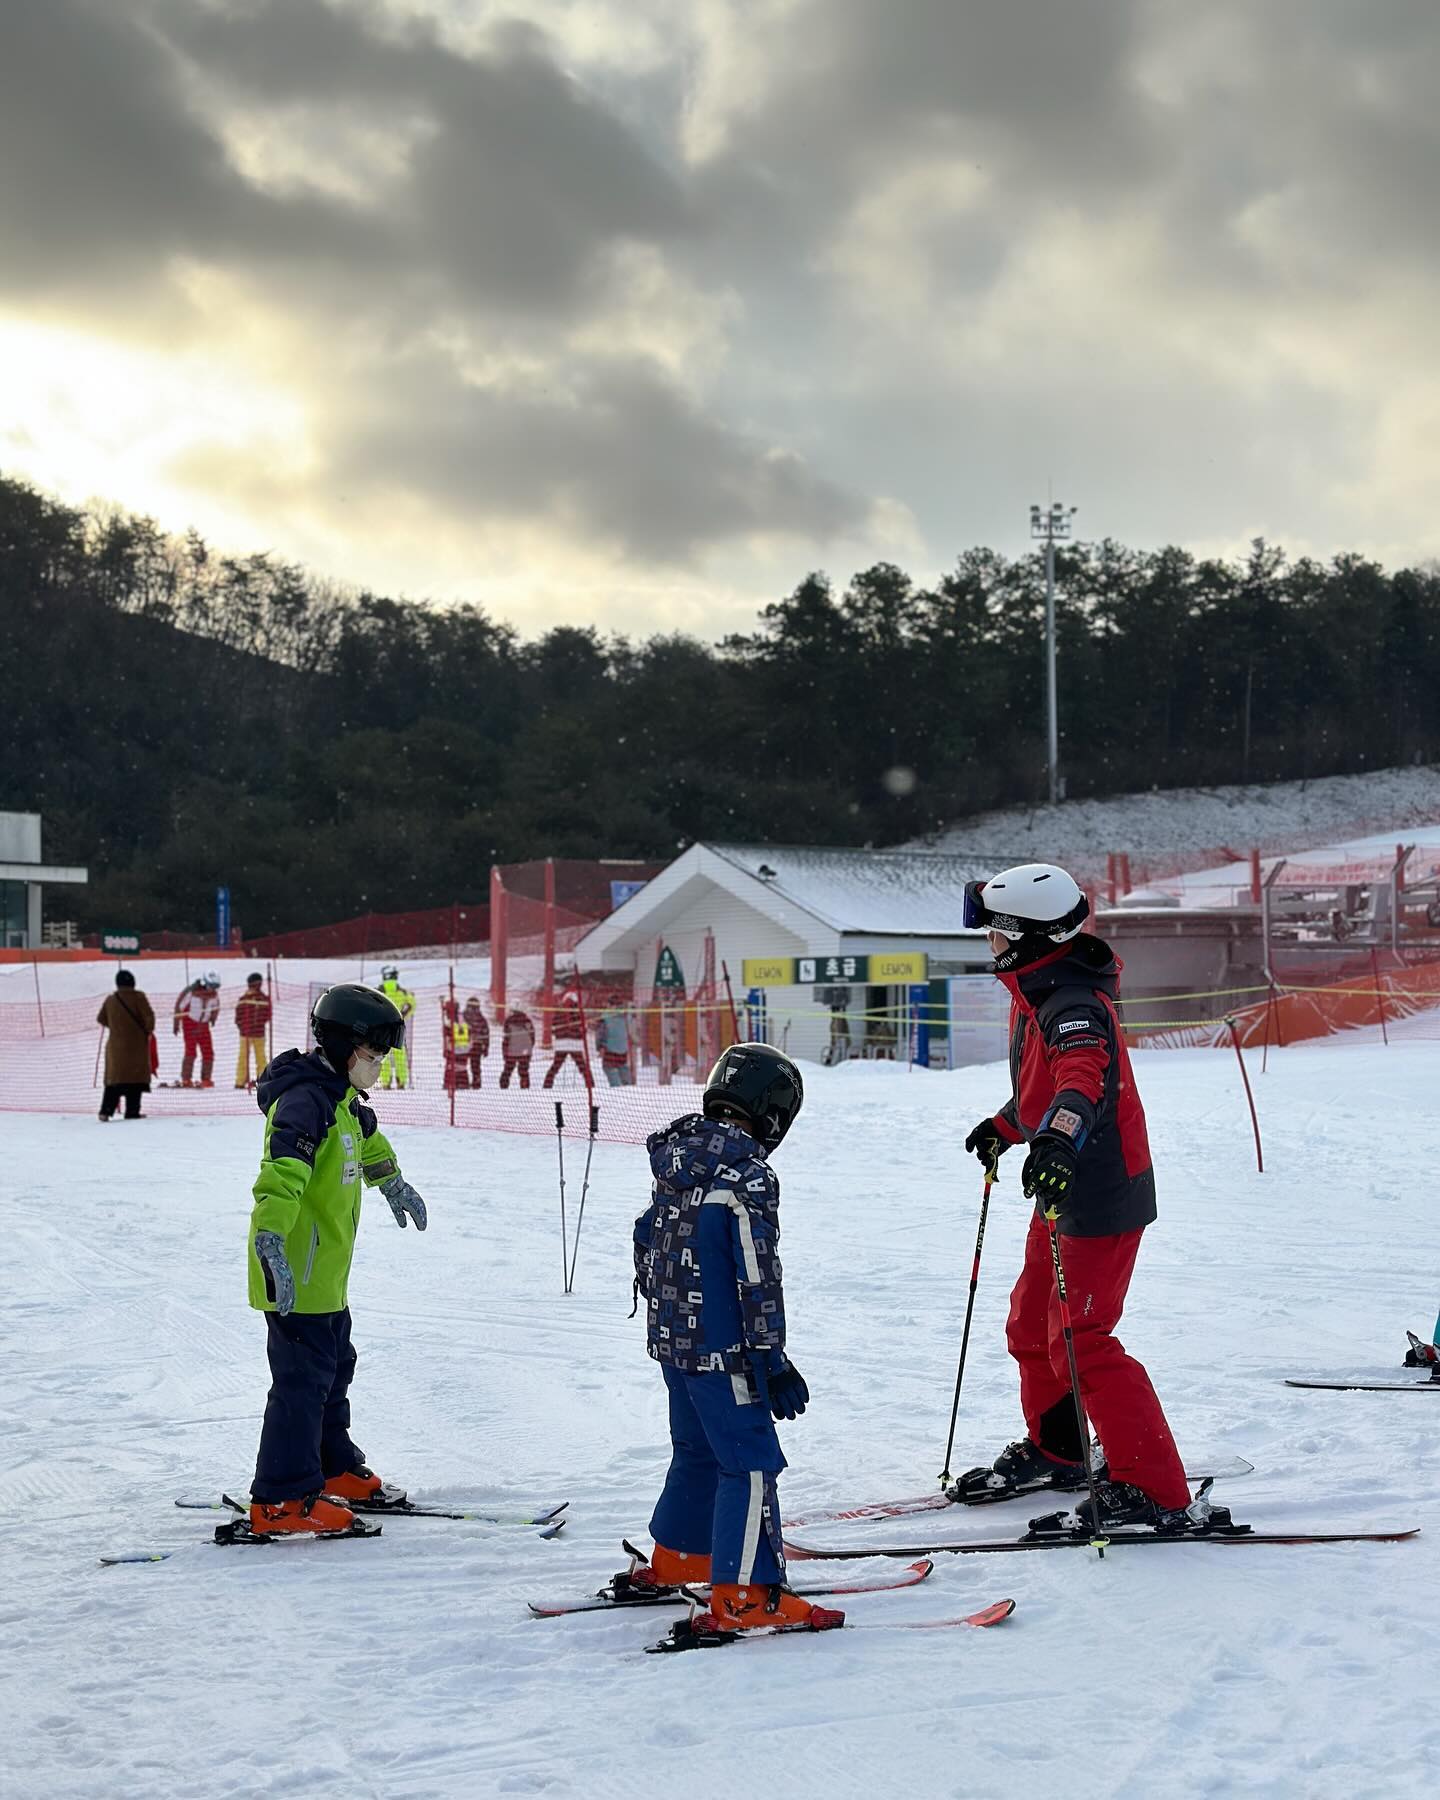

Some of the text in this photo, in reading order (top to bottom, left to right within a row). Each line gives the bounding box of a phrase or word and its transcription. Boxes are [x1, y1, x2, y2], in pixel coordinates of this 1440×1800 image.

[754, 966, 782, 979] LEMON
[826, 957, 856, 976] 초급
[881, 962, 913, 976] LEMON
[1050, 1161, 1072, 1176] LEKI
[1057, 1265, 1067, 1294] LEKI
